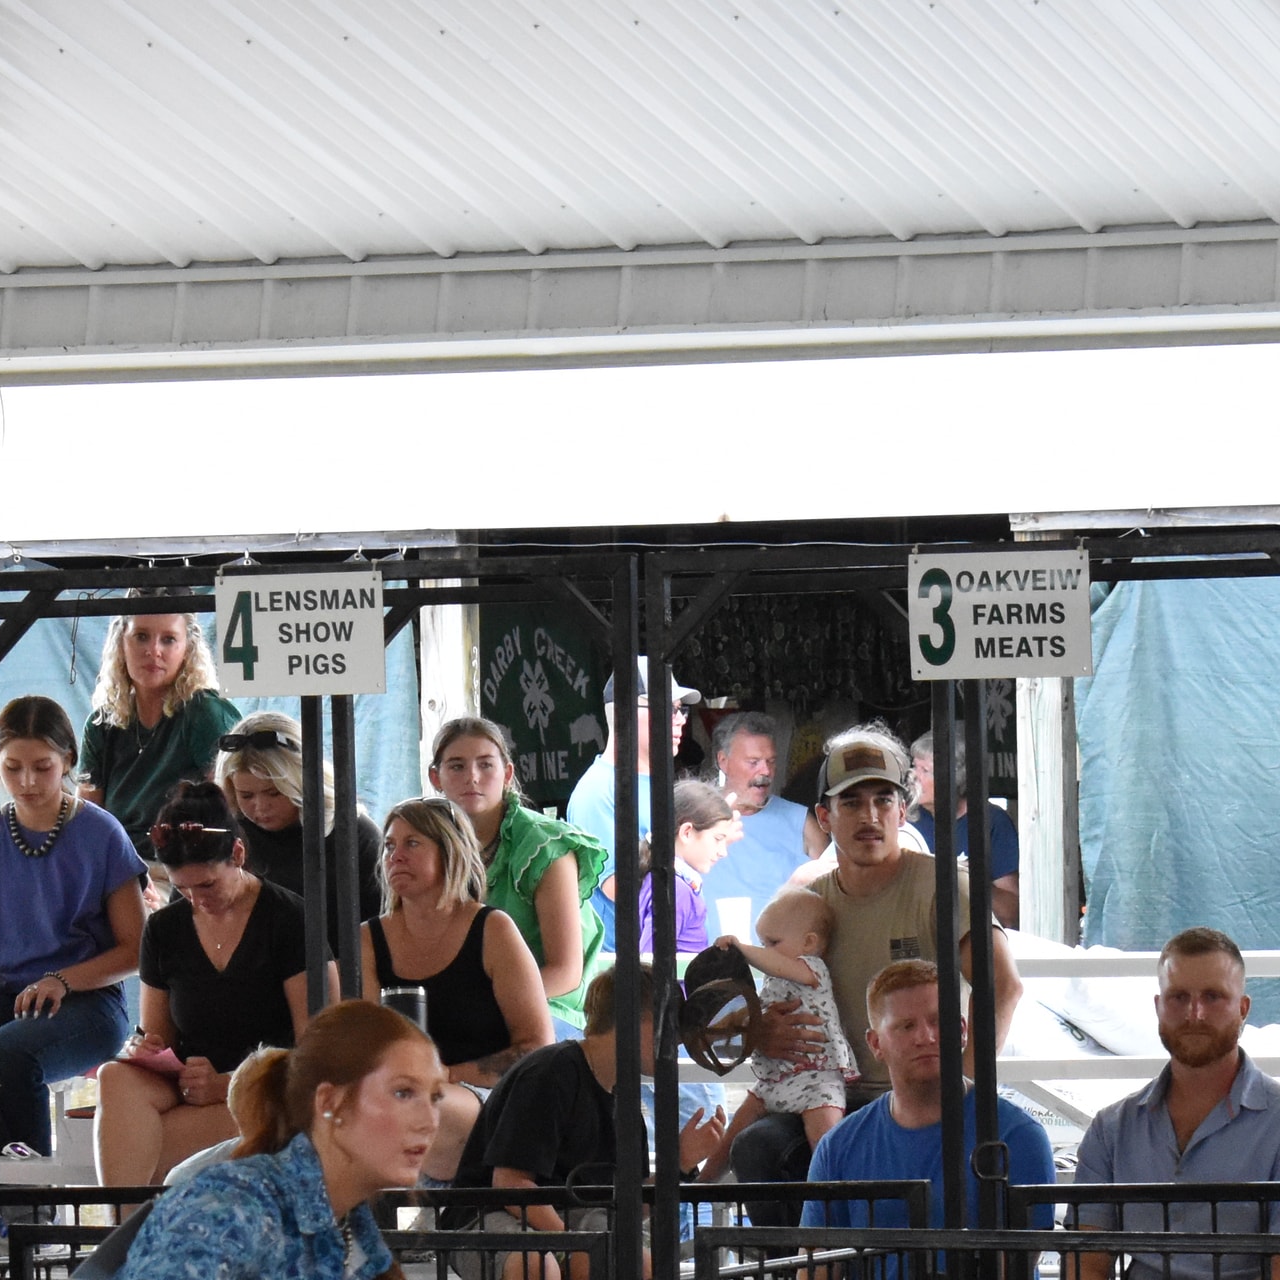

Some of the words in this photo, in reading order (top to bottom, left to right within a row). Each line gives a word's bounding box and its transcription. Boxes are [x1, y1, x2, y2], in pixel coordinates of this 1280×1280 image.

[955, 568, 1082, 593] OAKVEIW
[254, 588, 376, 613] LENSMAN
[918, 567, 956, 666] 3
[972, 601, 1066, 626] FARMS
[223, 590, 259, 681] 4
[278, 621, 354, 644] SHOW
[974, 636, 1066, 659] MEATS
[288, 653, 347, 676] PIGS
[484, 625, 523, 706] DARBY
[534, 628, 590, 699] CREEK
